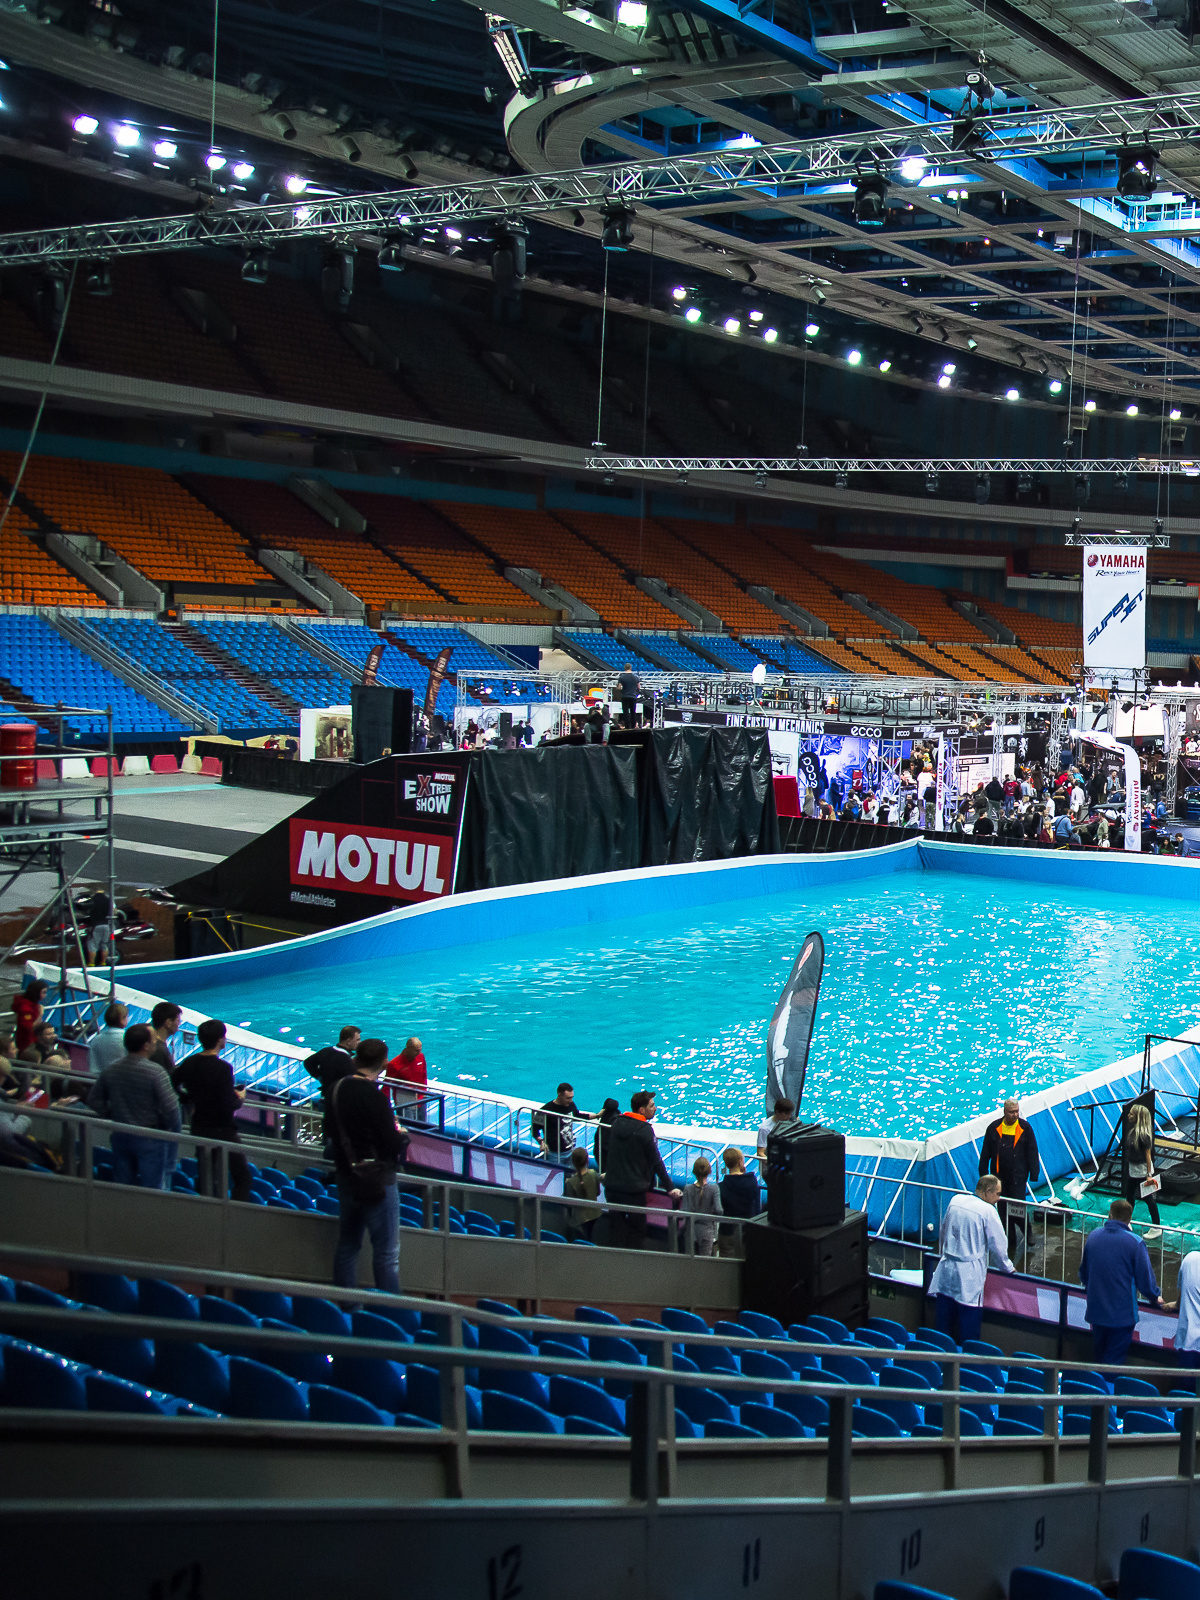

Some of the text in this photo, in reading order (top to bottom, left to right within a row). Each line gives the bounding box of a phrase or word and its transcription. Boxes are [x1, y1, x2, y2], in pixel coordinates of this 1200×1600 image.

[1100, 554, 1145, 568] YAMAHA
[1087, 592, 1130, 646] SUPER
[1120, 588, 1145, 624] JET
[726, 713, 825, 735] FINE CUSTOM MECHANICS
[850, 726, 882, 738] ecco
[404, 774, 452, 800] EXTREME
[434, 772, 455, 782] MOTUL
[802, 756, 818, 789] ecco
[416, 794, 451, 815] SHOW
[297, 829, 446, 895] MOTUL
[1033, 1515, 1047, 1553] 9
[1139, 1512, 1150, 1545] 8
[741, 1537, 762, 1588] 11
[899, 1528, 922, 1576] 10
[485, 1543, 524, 1599] 12
